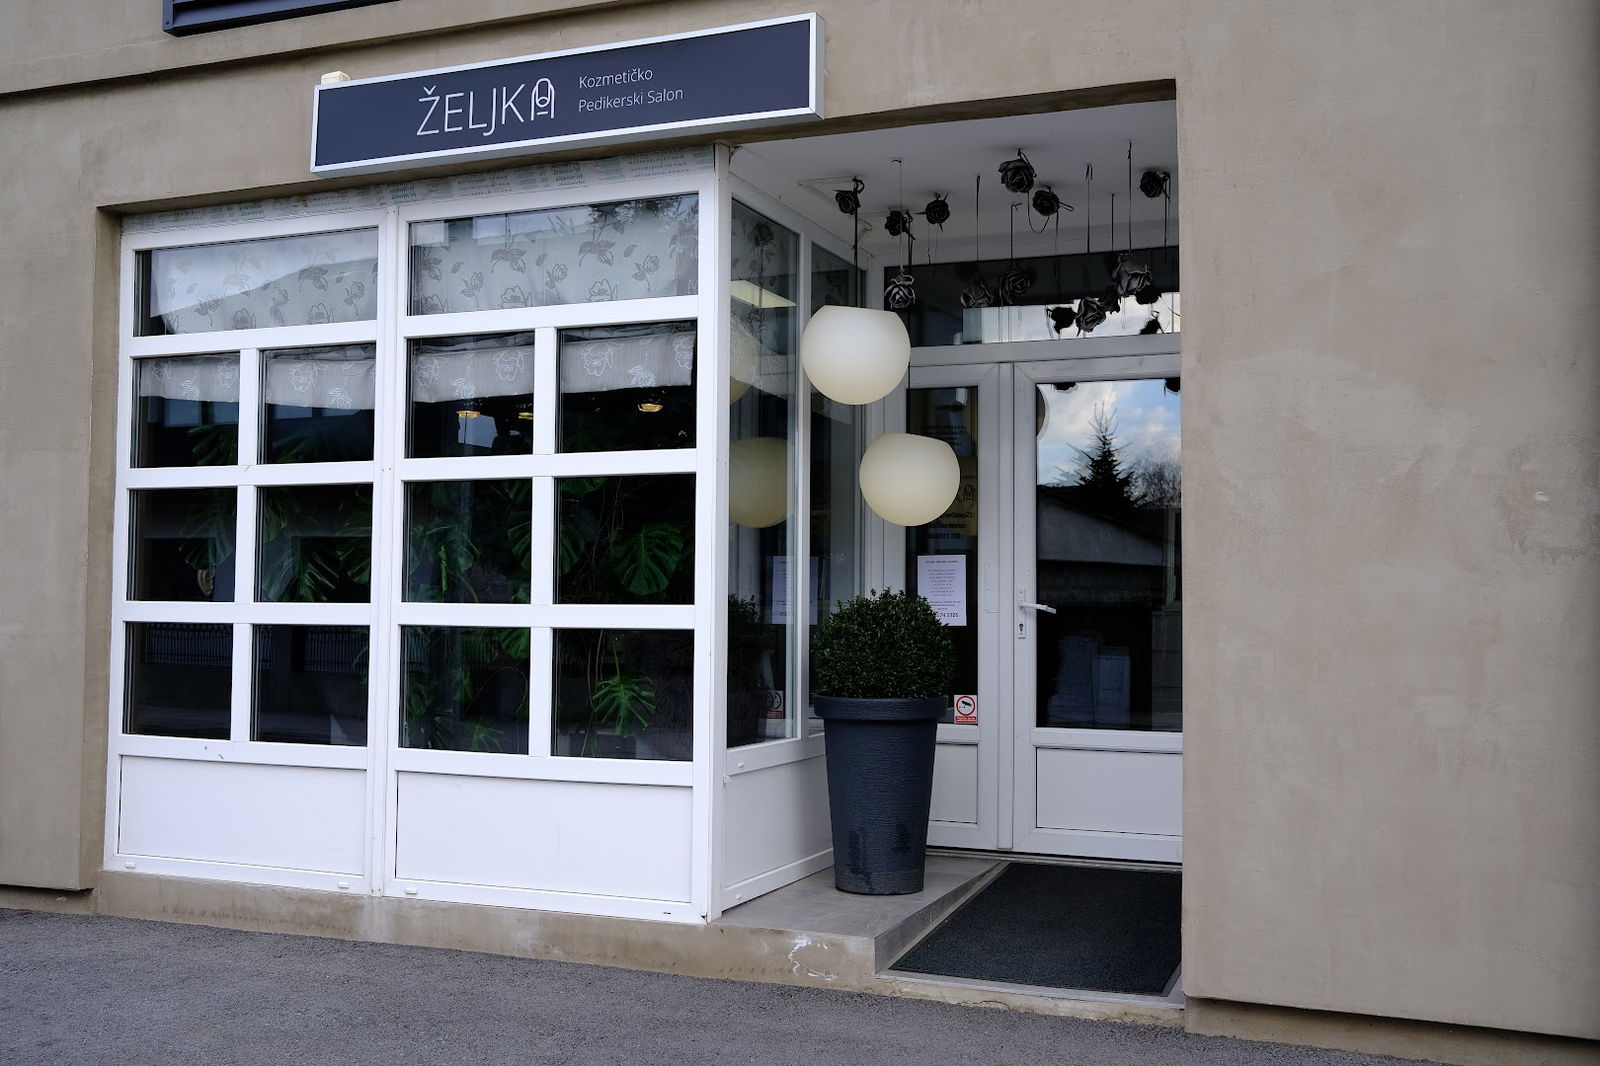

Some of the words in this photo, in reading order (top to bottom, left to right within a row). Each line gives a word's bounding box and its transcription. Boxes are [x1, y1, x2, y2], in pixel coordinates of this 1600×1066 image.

[579, 67, 653, 89] Kozmetičko
[416, 77, 555, 136] ŽELJKA
[578, 91, 644, 112] Pedikerski
[647, 88, 684, 105] Salon
